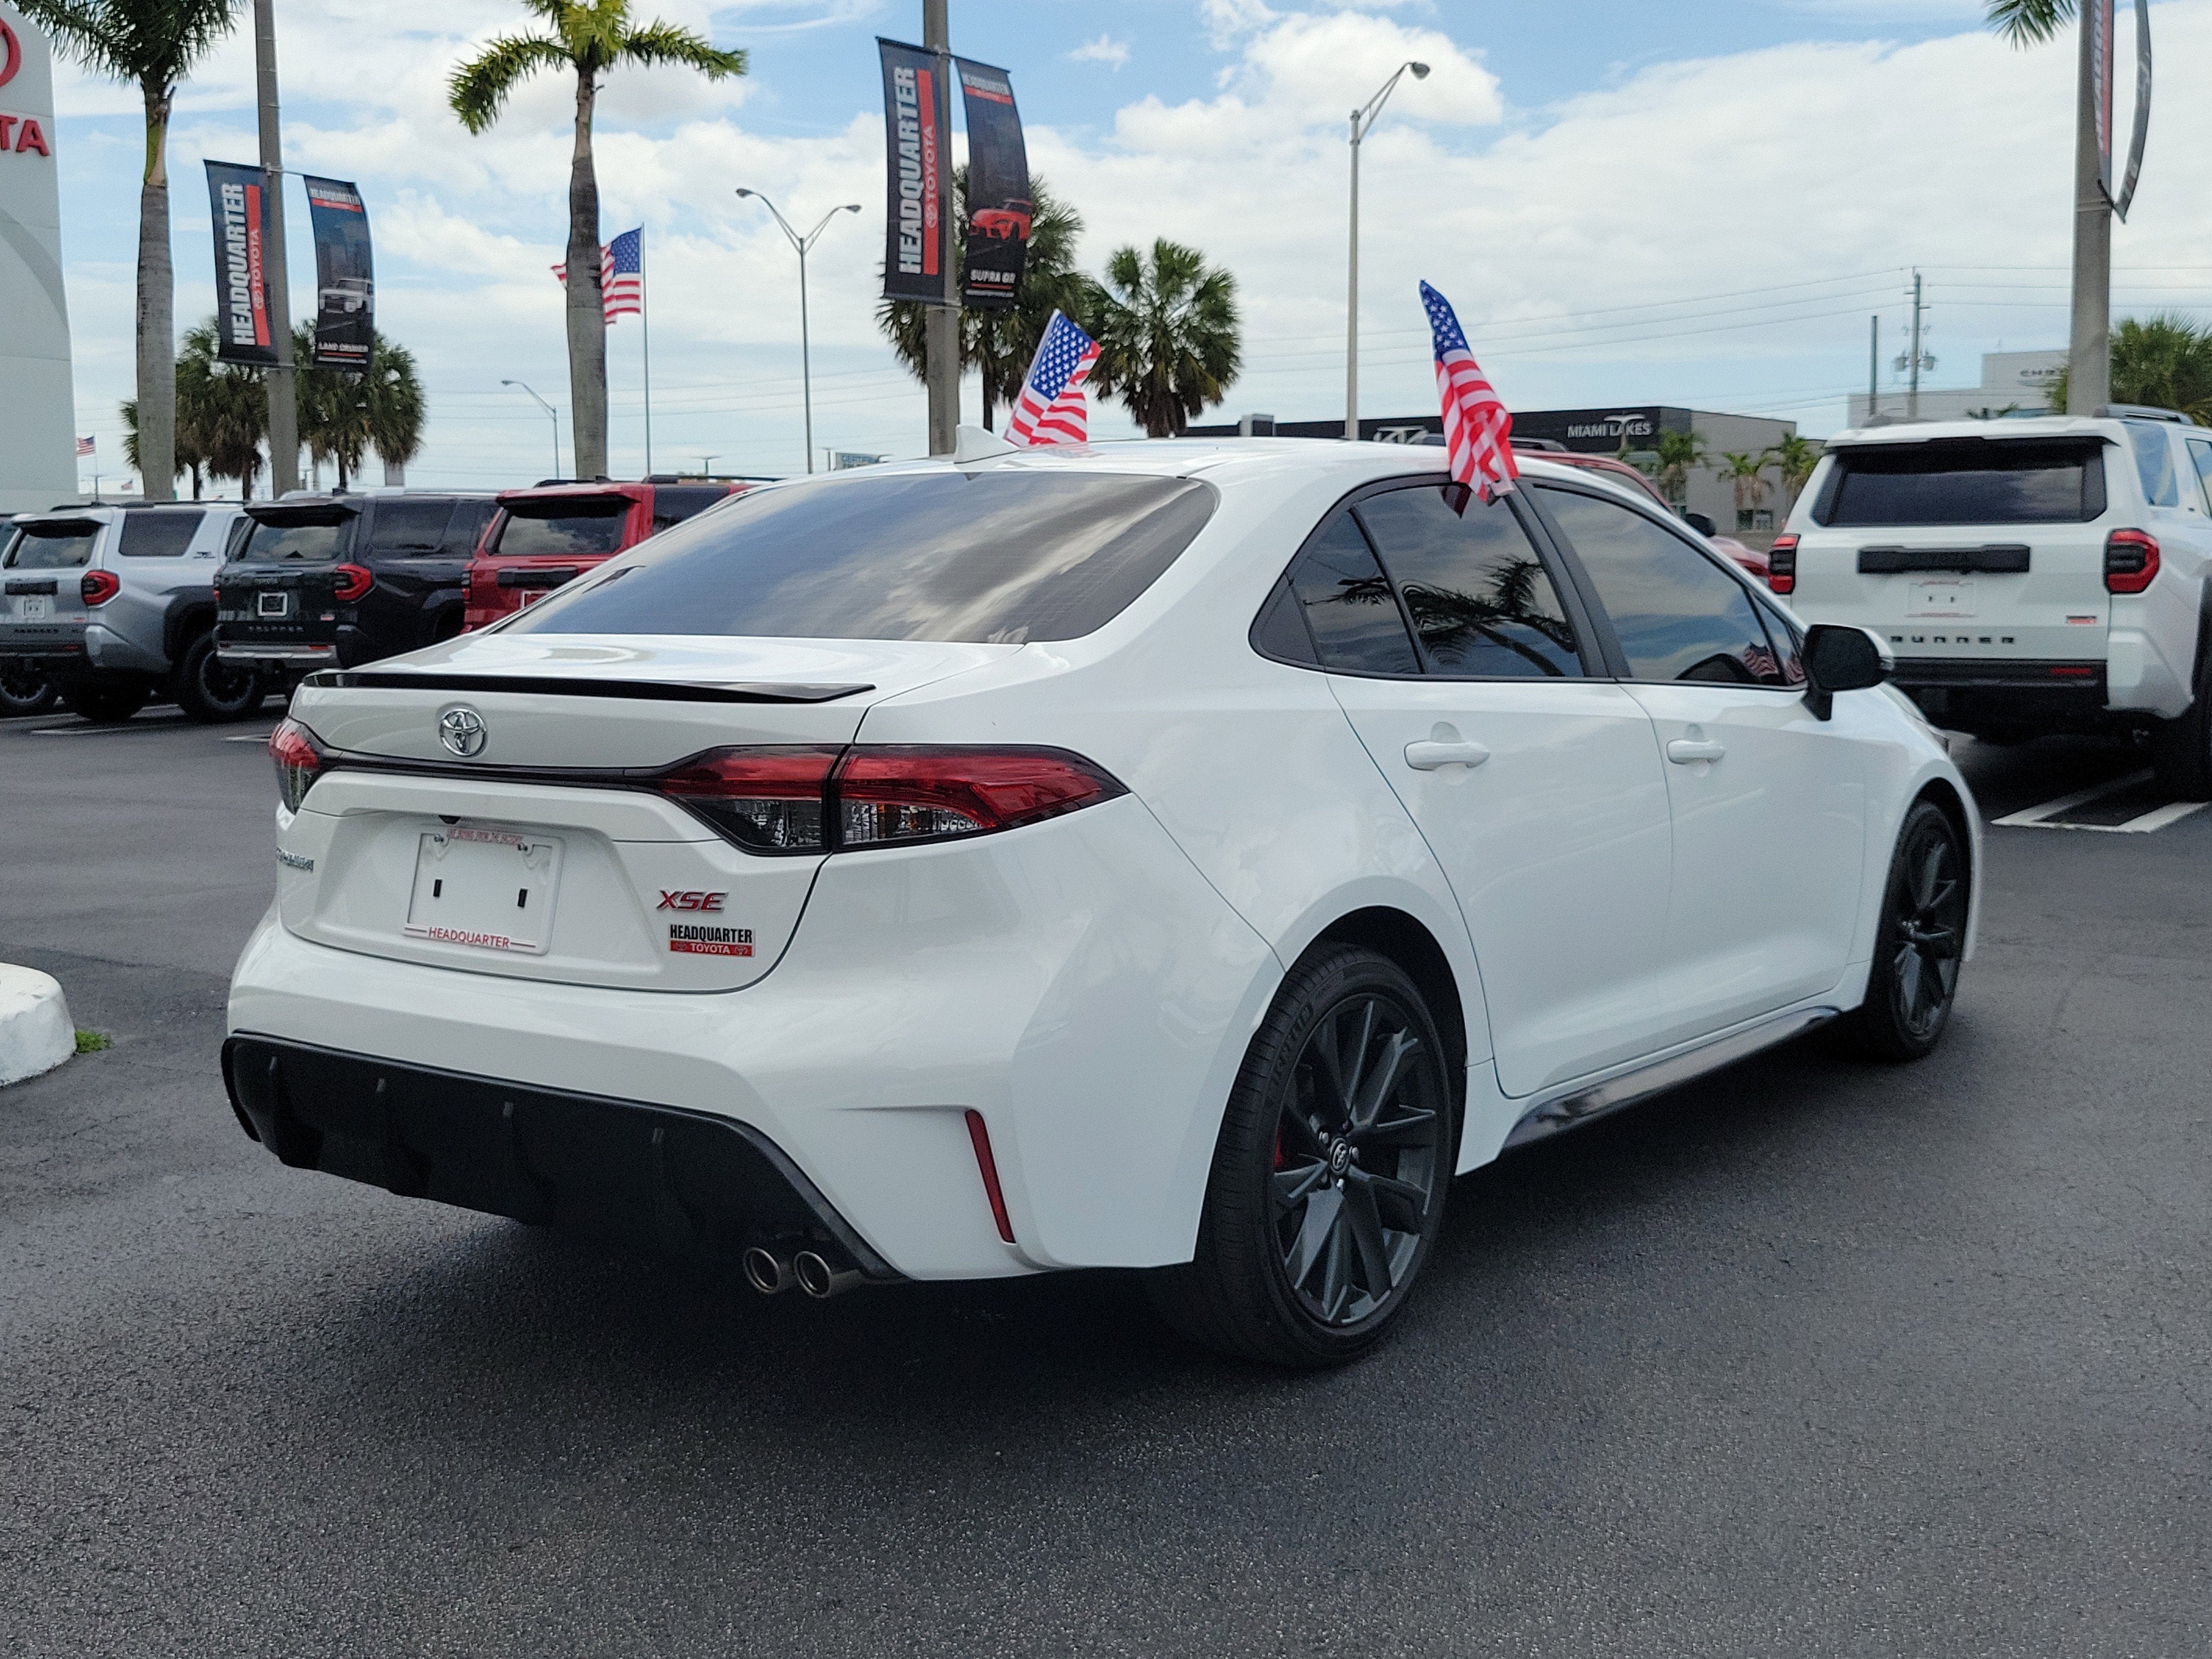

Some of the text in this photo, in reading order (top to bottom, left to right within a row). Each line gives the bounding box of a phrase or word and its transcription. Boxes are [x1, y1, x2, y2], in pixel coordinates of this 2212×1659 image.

[894, 66, 923, 274] HEADQUARTER
[924, 126, 936, 201] TOYOTA
[222, 183, 256, 346] HEADQUARTER
[250, 230, 262, 290] TOYOTA
[1567, 421, 1651, 438] MIAMI LAKES
[656, 889, 729, 913] XSE
[428, 926, 510, 949] HEADQUARTER
[670, 924, 753, 944] HEADQUARTER
[690, 943, 731, 955] TOYOTA
